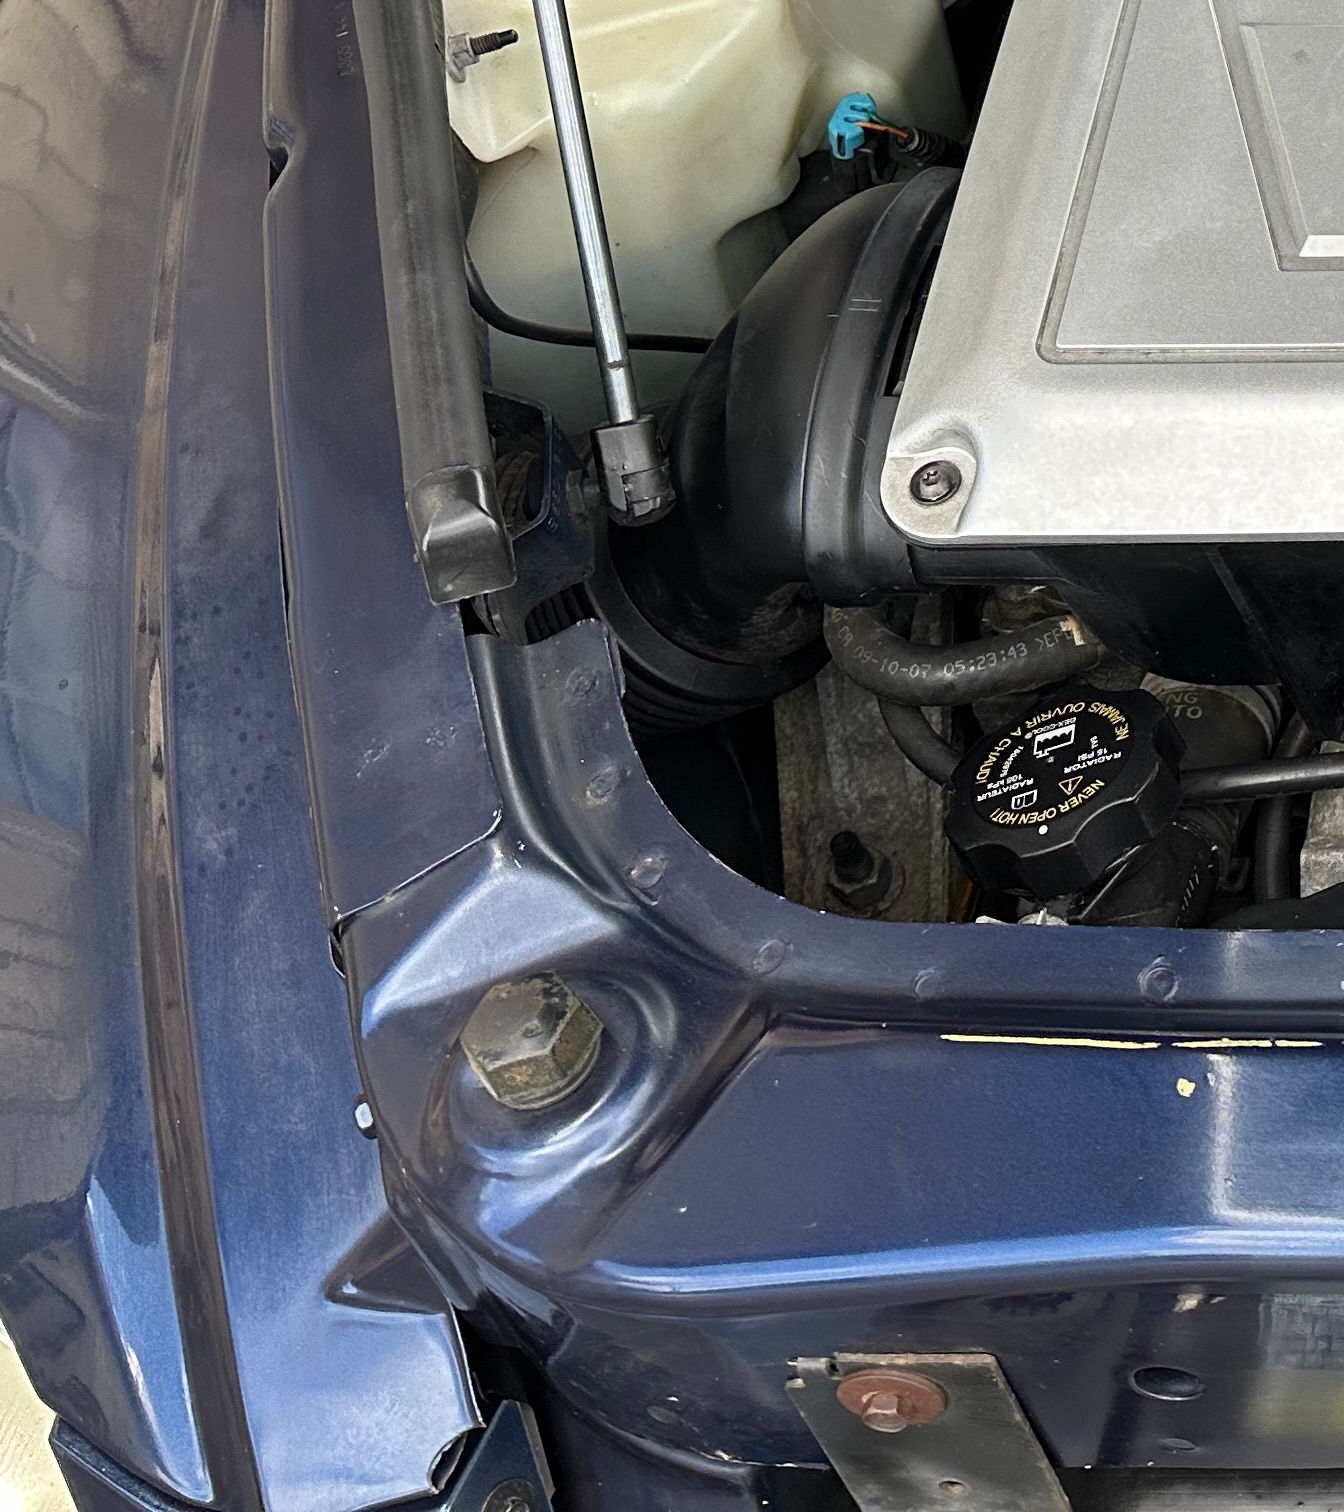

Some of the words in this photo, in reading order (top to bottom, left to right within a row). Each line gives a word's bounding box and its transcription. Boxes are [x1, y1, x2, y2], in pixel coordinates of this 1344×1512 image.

[943, 642, 1028, 677] 05:23:43
[1166, 692, 1199, 705] NG
[1025, 701, 1085, 728] OUVRIR
[1088, 701, 1125, 728] JAMAIS
[975, 738, 1011, 785] CHAUD!
[1064, 751, 1122, 773] RADIATOR
[1077, 751, 1094, 761] PSI
[976, 778, 1034, 801] RADIATEUR
[1057, 779, 1105, 813] NEVER
[989, 807, 1019, 825] HOT!
[1019, 807, 1057, 825] OPEN
